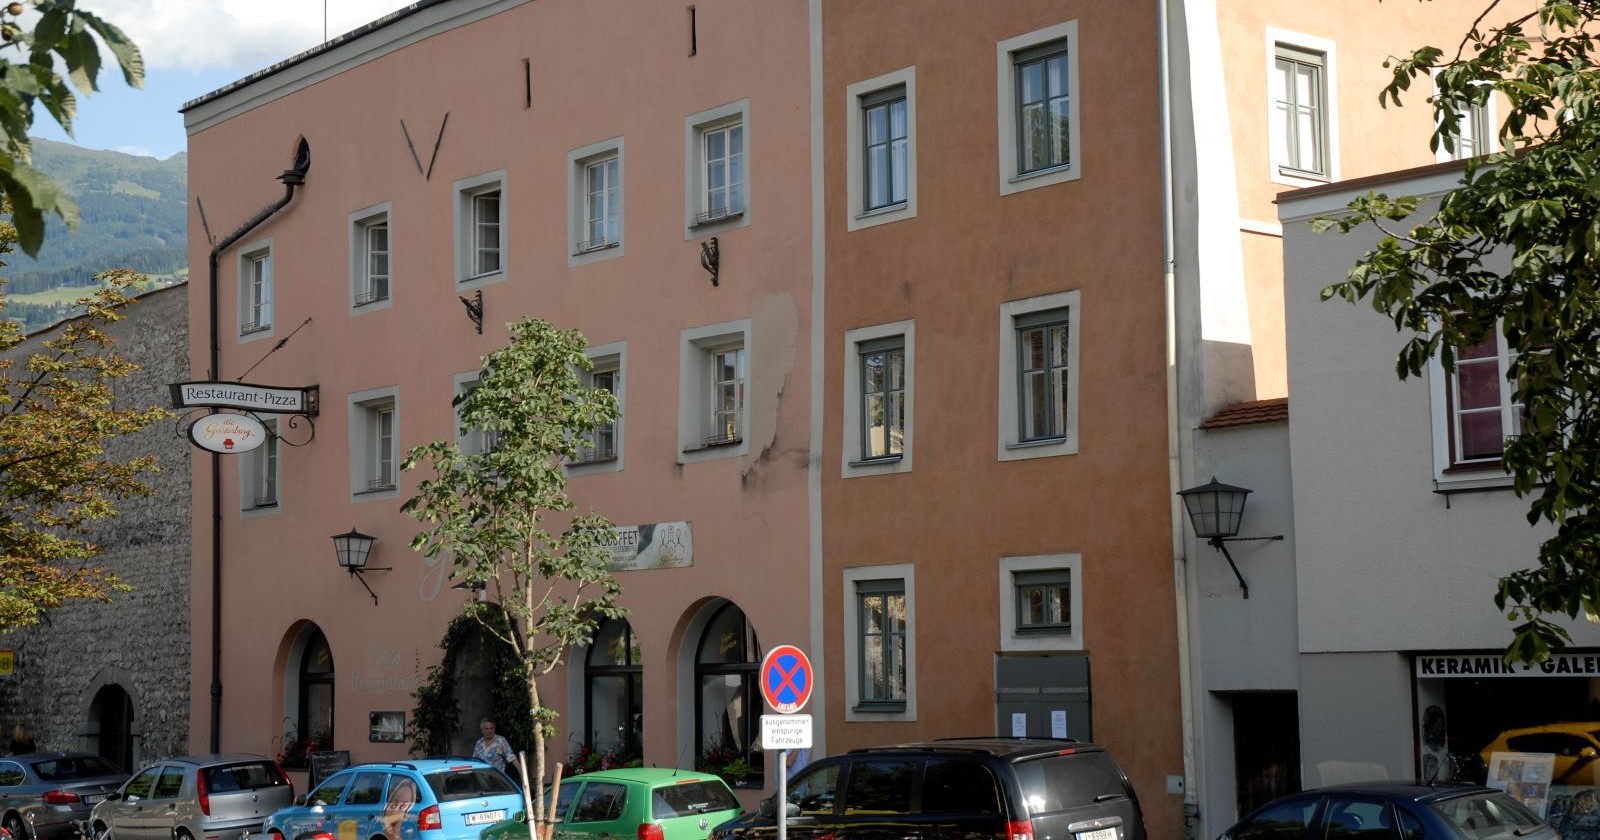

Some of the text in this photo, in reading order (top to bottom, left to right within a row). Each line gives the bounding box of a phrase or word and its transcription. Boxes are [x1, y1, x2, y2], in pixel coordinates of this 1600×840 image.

[187, 388, 296, 405] Restaurant-Pizza
[1422, 657, 1515, 674] KERAMIK
[771, 736, 803, 744] Fahrzeuge
